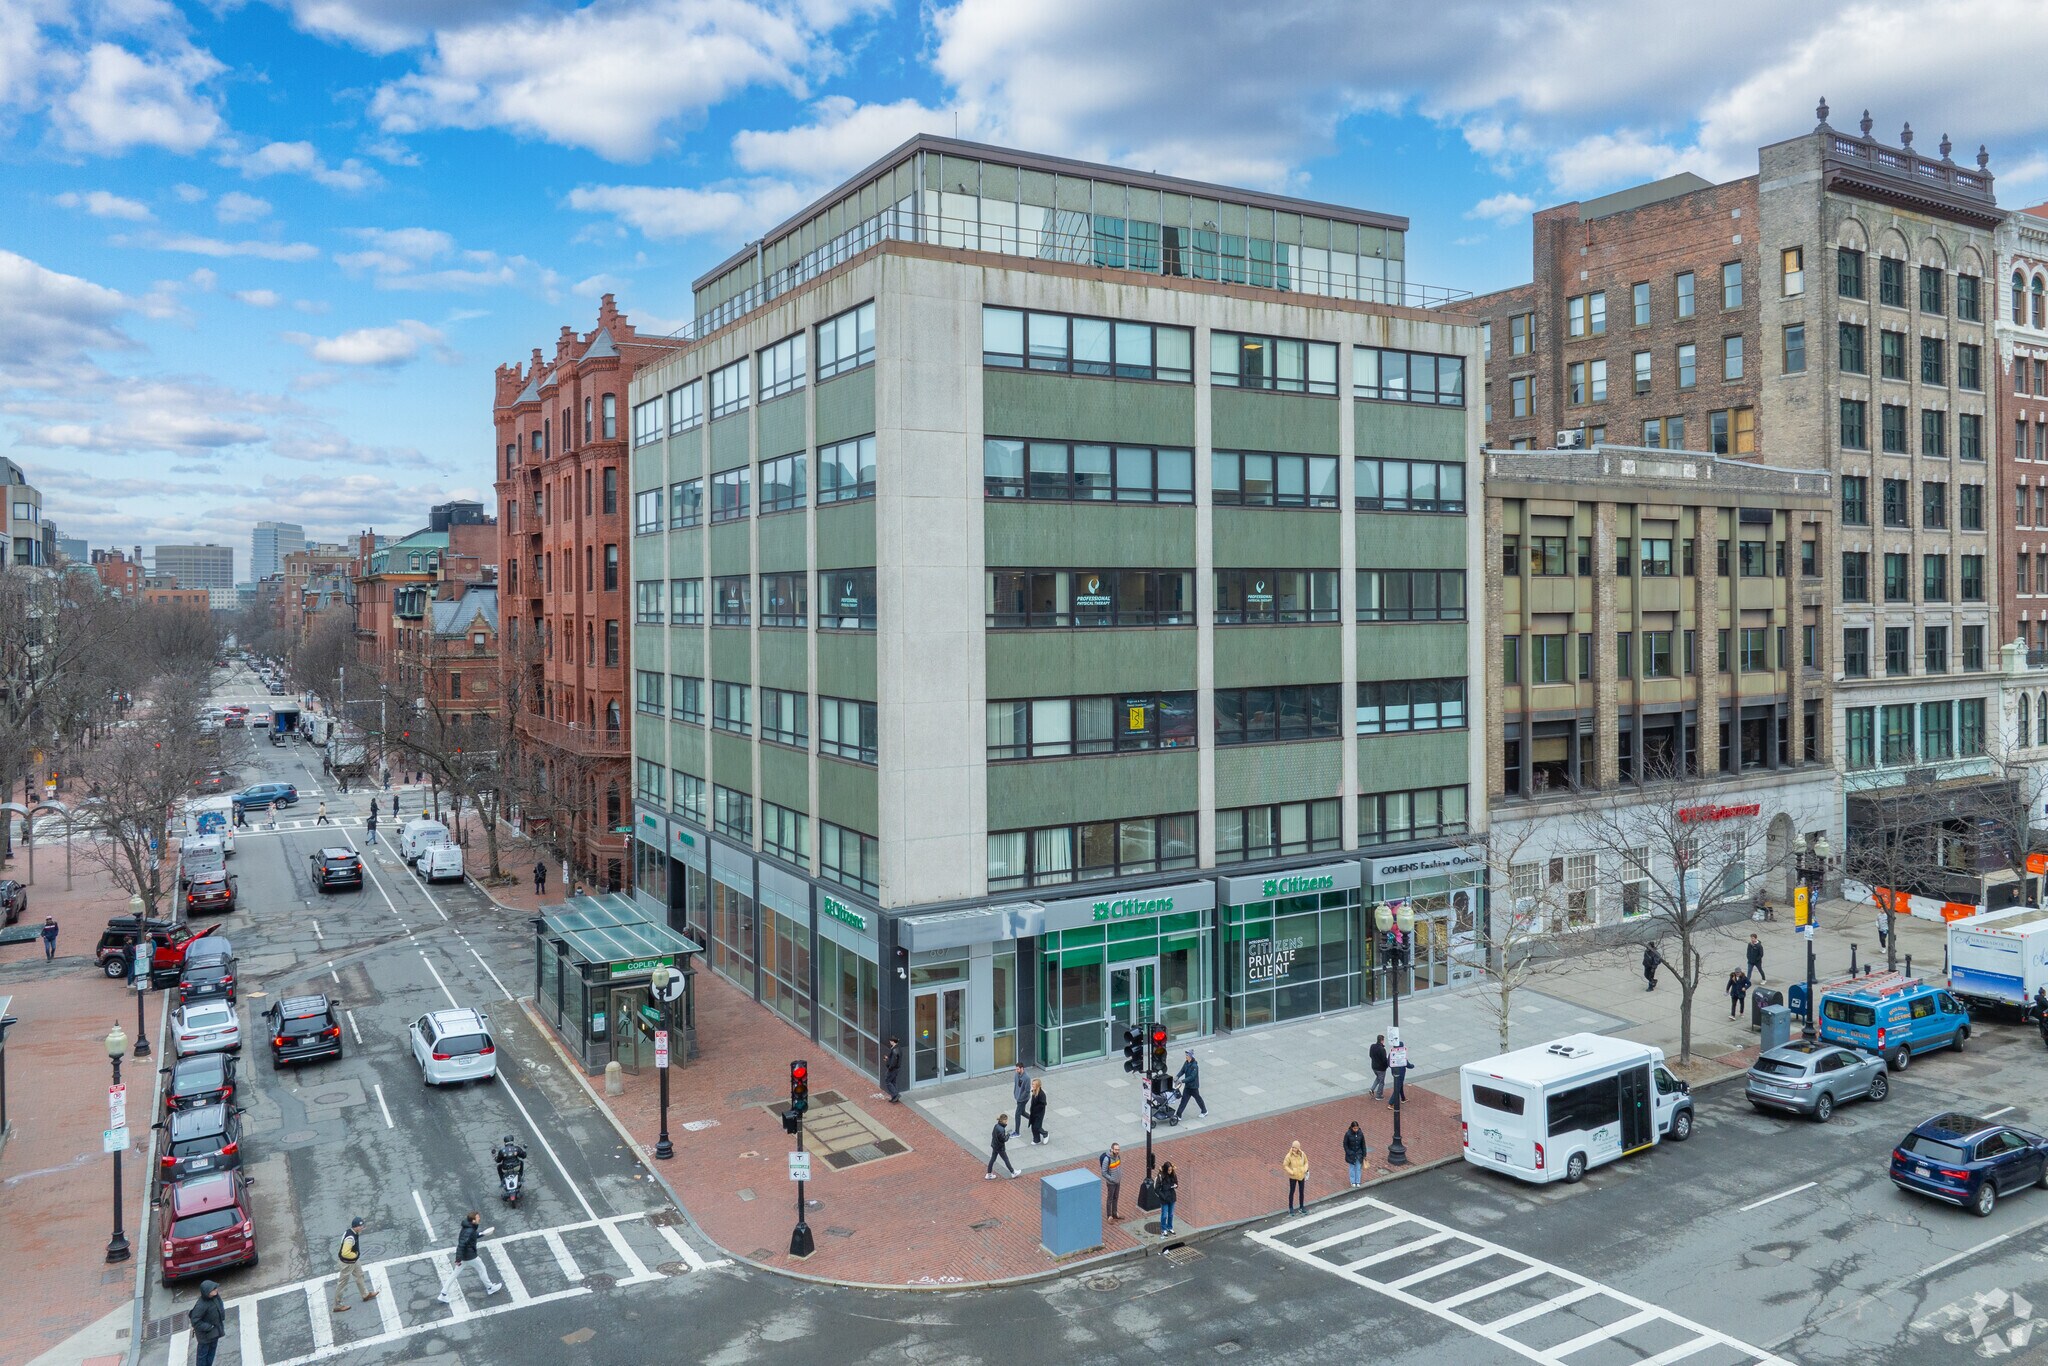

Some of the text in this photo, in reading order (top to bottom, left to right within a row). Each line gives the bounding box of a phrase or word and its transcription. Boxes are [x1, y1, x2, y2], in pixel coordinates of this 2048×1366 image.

[1382, 862, 1418, 875] COHEN'S
[1421, 860, 1450, 869] Fashion
[1278, 874, 1333, 894] Citizens
[833, 900, 866, 931] Citizens
[1111, 897, 1173, 919] Citizens
[1249, 936, 1303, 956] CITIZENS
[628, 960, 657, 970] COPLEY
[1249, 950, 1295, 968] PRIVATE
[1249, 962, 1289, 979] CLIENT
